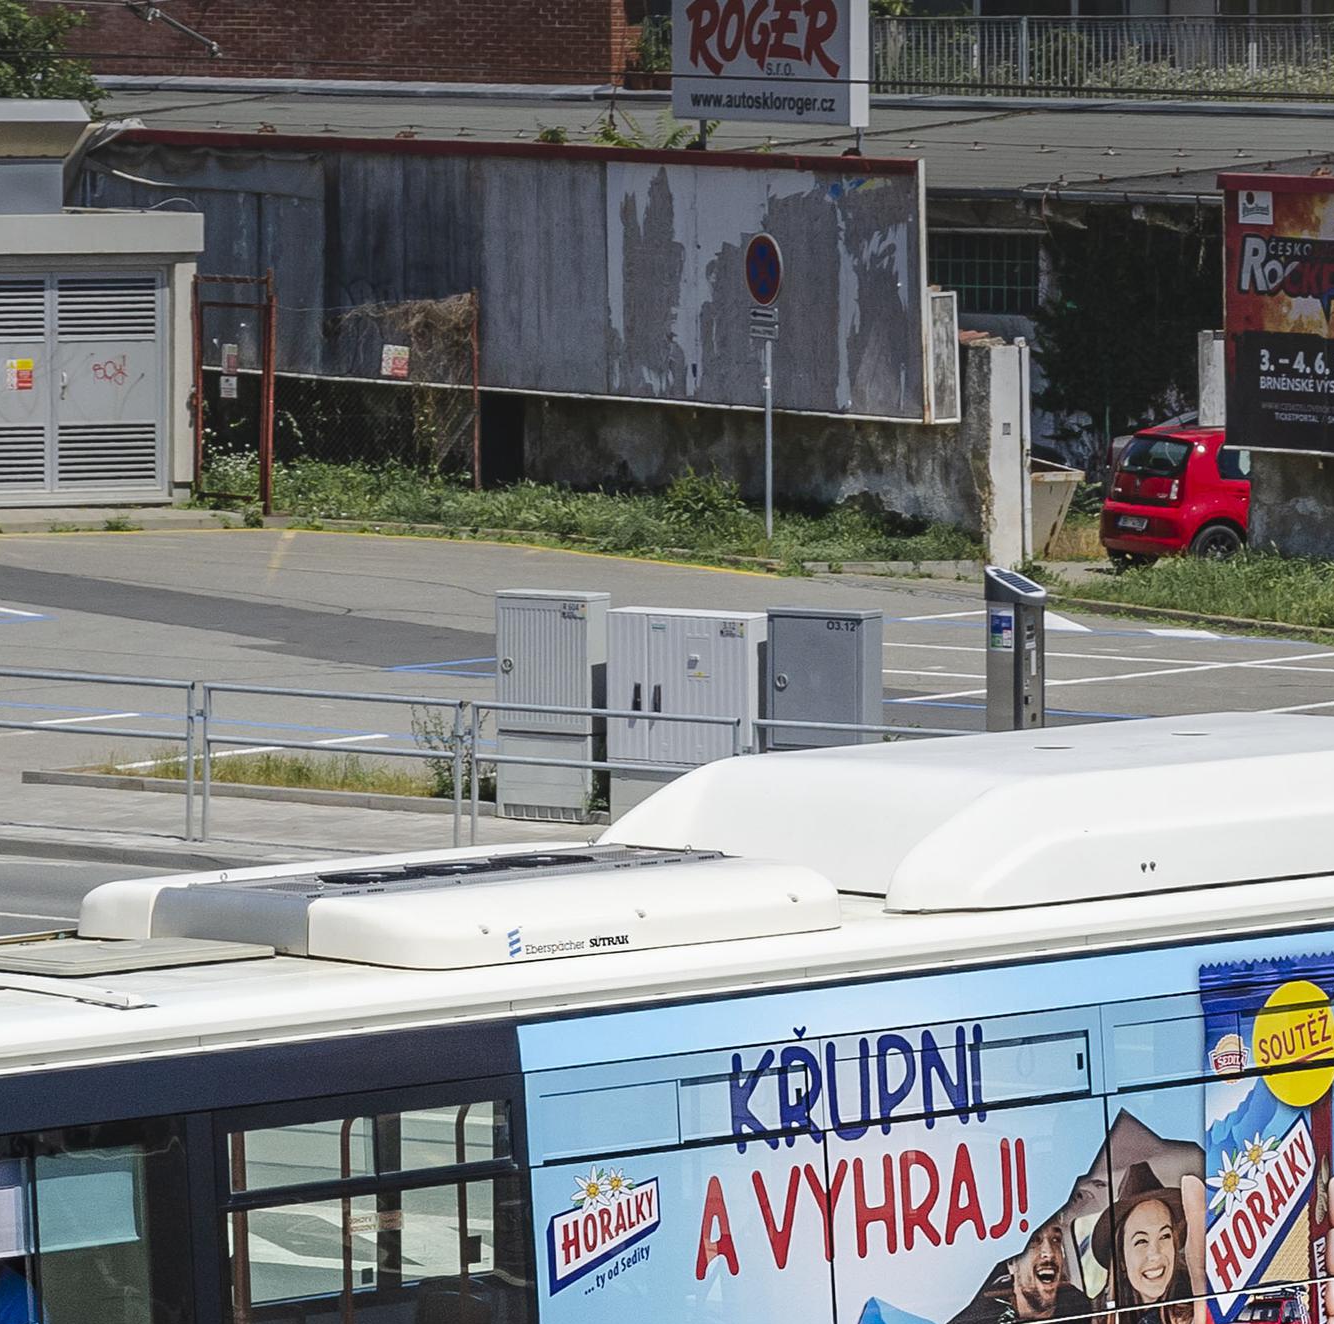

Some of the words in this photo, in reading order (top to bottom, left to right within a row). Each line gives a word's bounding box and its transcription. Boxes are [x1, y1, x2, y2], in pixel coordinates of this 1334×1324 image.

[686, 0, 840, 78] ROGER
[766, 61, 795, 77] s.r.o.
[690, 91, 835, 115] www.autoskloroger.cz
[1260, 349, 1275, 371] 3.
[1260, 373, 1314, 392] BRNĚNSKÉ
[525, 939, 585, 954] Eberspächer
[589, 935, 629, 948] SÜTRAK
[1258, 1010, 1332, 1065] SOUTĚŽ
[730, 1023, 987, 1154] KŘUPNI
[561, 1187, 655, 1266] HORALKY
[695, 1175, 739, 1281] A
[752, 1138, 1030, 1269] VYHRAJ!
[1210, 1130, 1312, 1291] HORALKY
[607, 1262, 620, 1282] od
[620, 1244, 651, 1278] Sedity
